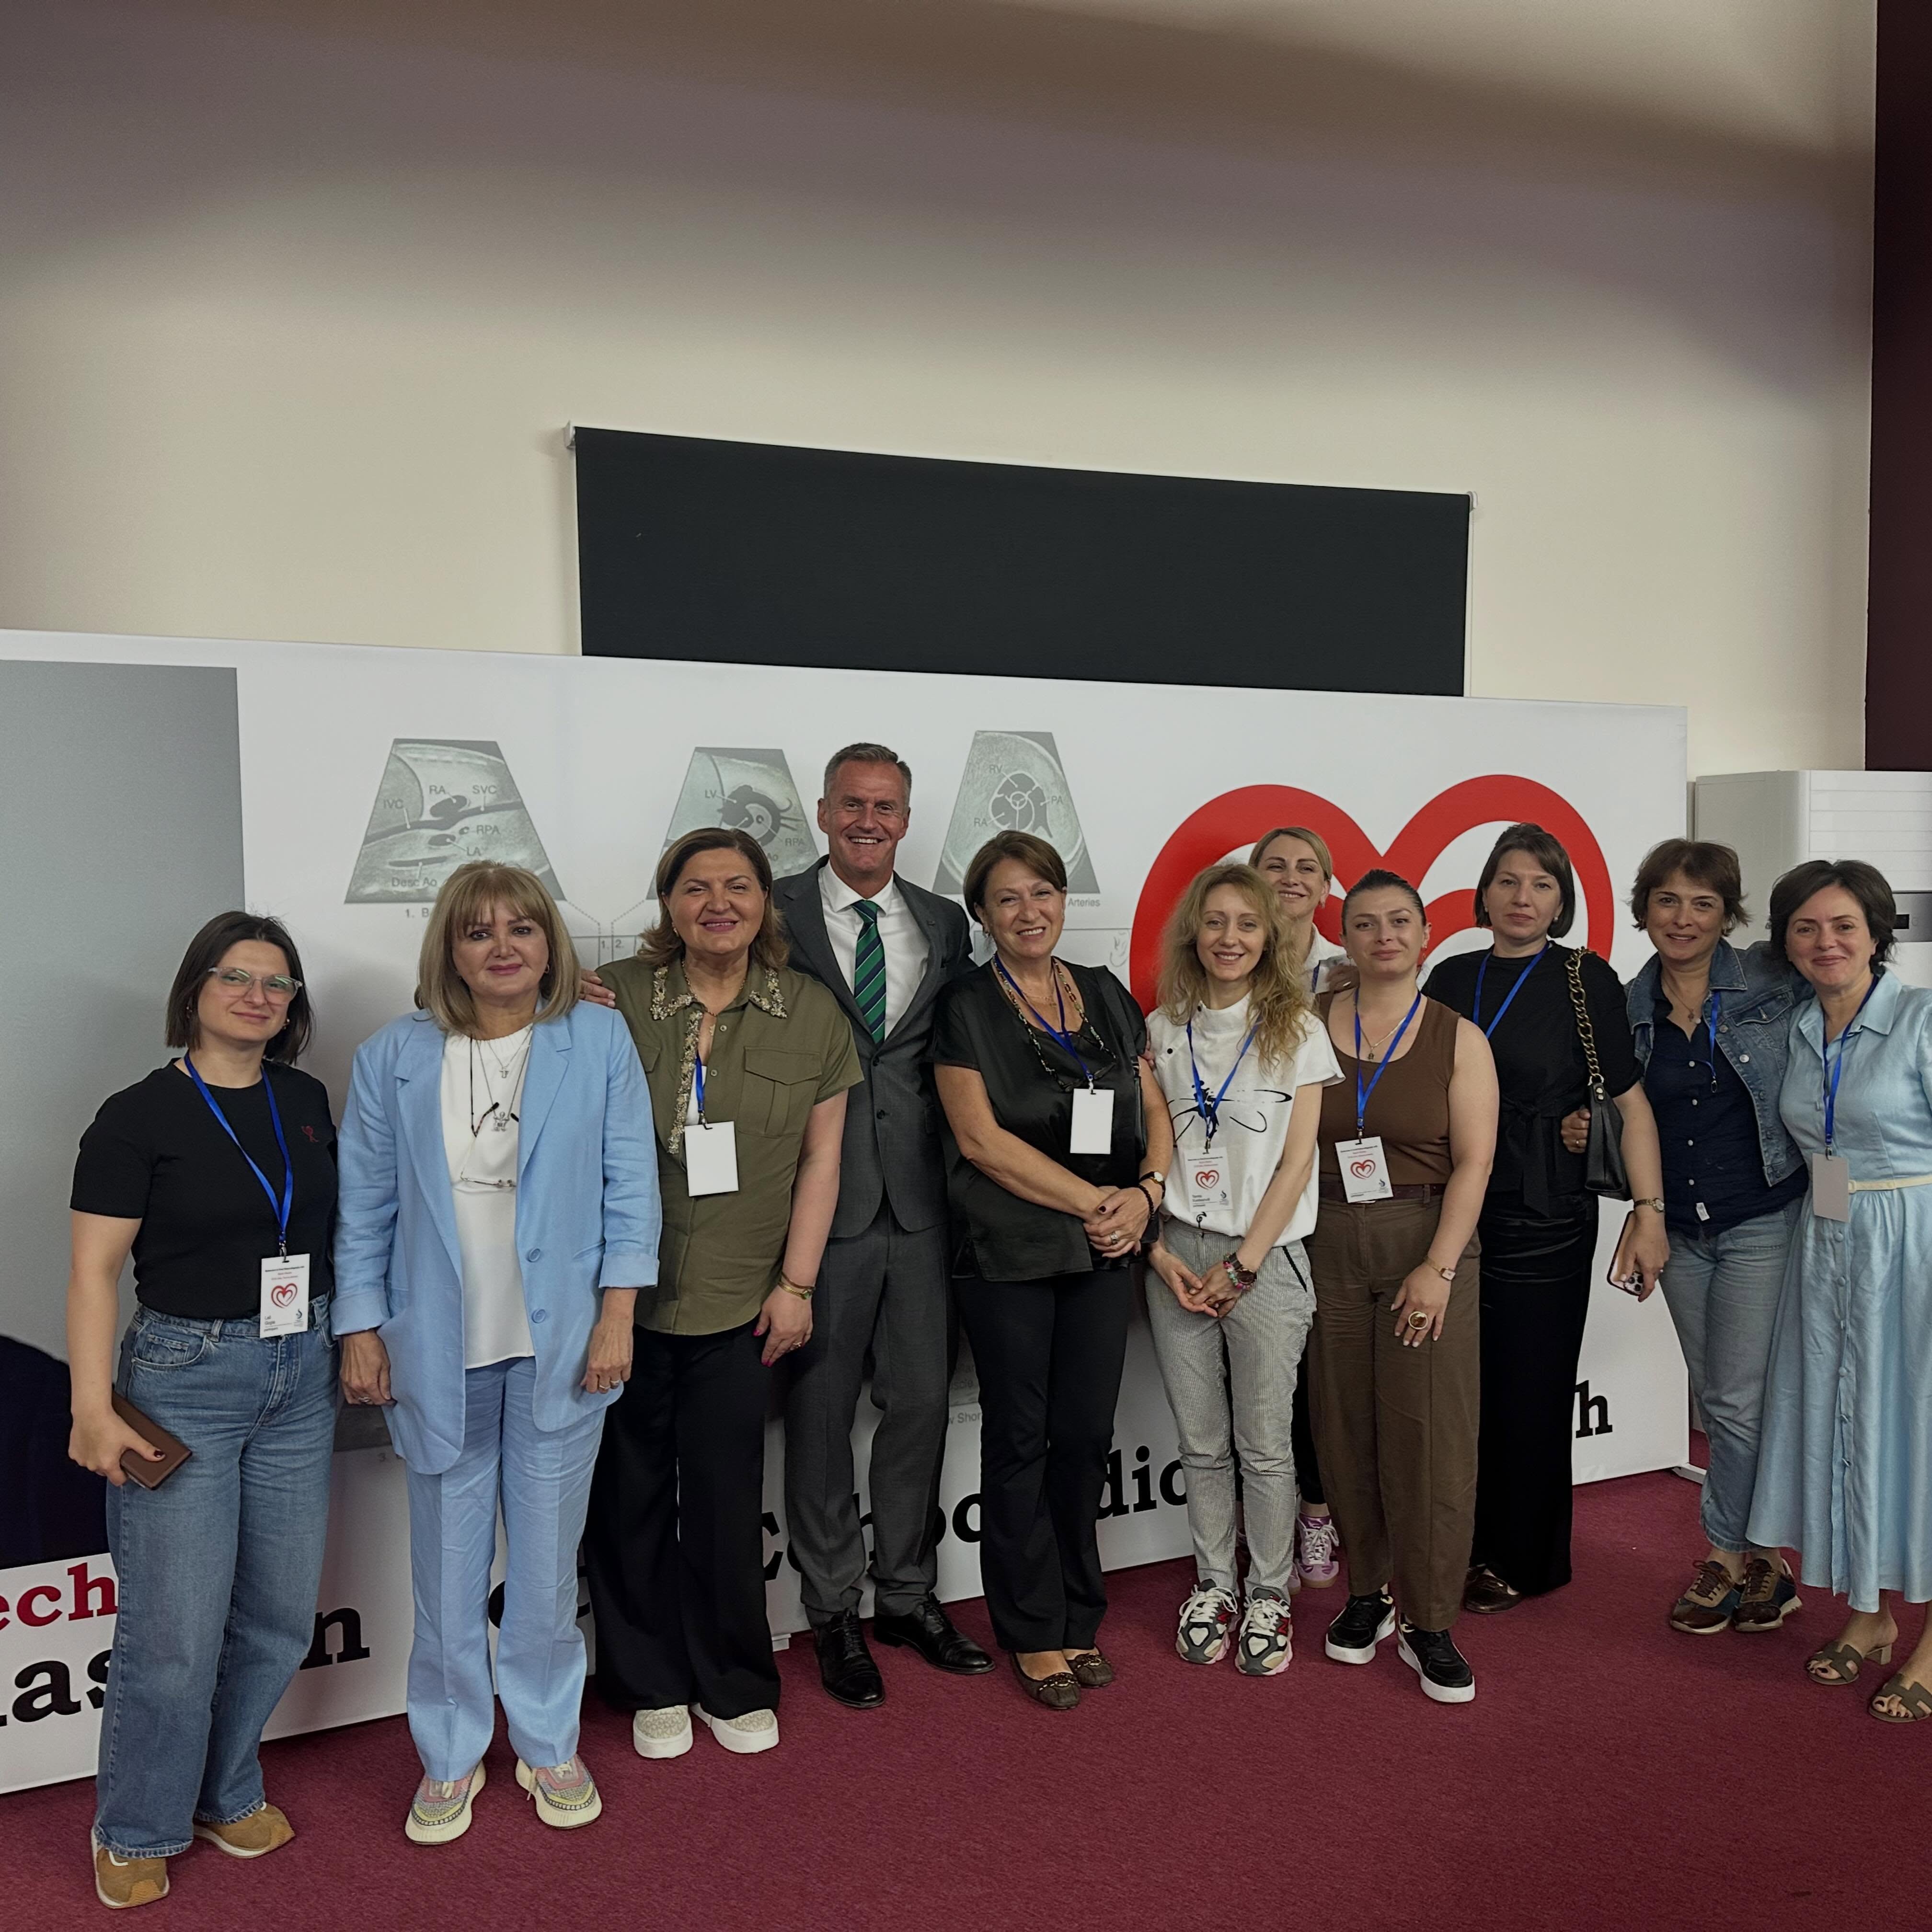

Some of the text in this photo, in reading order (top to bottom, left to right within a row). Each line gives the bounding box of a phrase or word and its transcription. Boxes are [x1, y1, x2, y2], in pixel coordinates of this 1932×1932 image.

[989, 765, 1002, 773] RV
[429, 785, 446, 794] RA
[472, 785, 497, 794] SVC
[705, 789, 717, 799] LV
[384, 799, 403, 809] IVC
[974, 817, 988, 827] RA
[476, 826, 500, 835] RPA
[467, 847, 482, 856] LA
[391, 877, 437, 887] Desc Ao
[1067, 898, 1101, 907] Arteries
